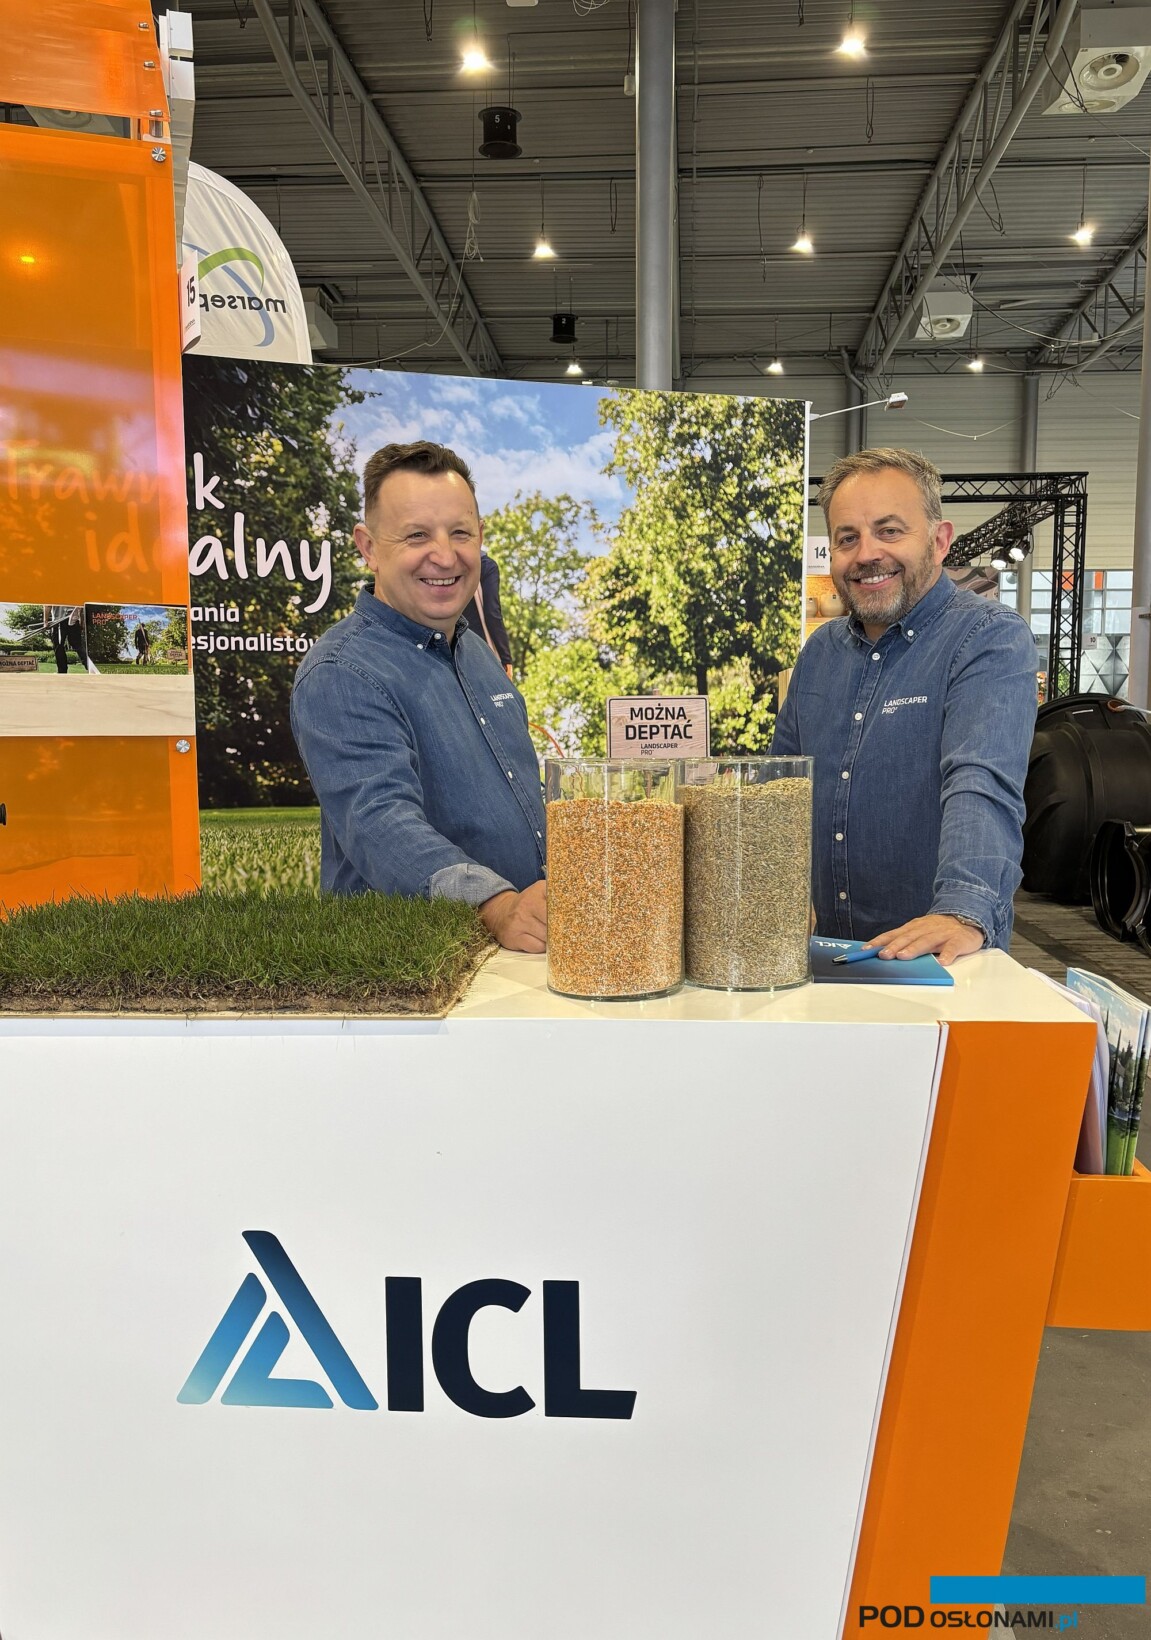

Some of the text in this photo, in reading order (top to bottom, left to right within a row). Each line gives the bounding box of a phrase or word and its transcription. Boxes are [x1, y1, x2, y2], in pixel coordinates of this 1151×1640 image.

[186, 275, 196, 308] 15
[814, 546, 827, 559] 14
[883, 695, 928, 707] LANDSCAPER
[630, 703, 688, 720] MOŻNA
[625, 720, 693, 740] DEPTAĆ
[385, 1276, 637, 1419] ICL
